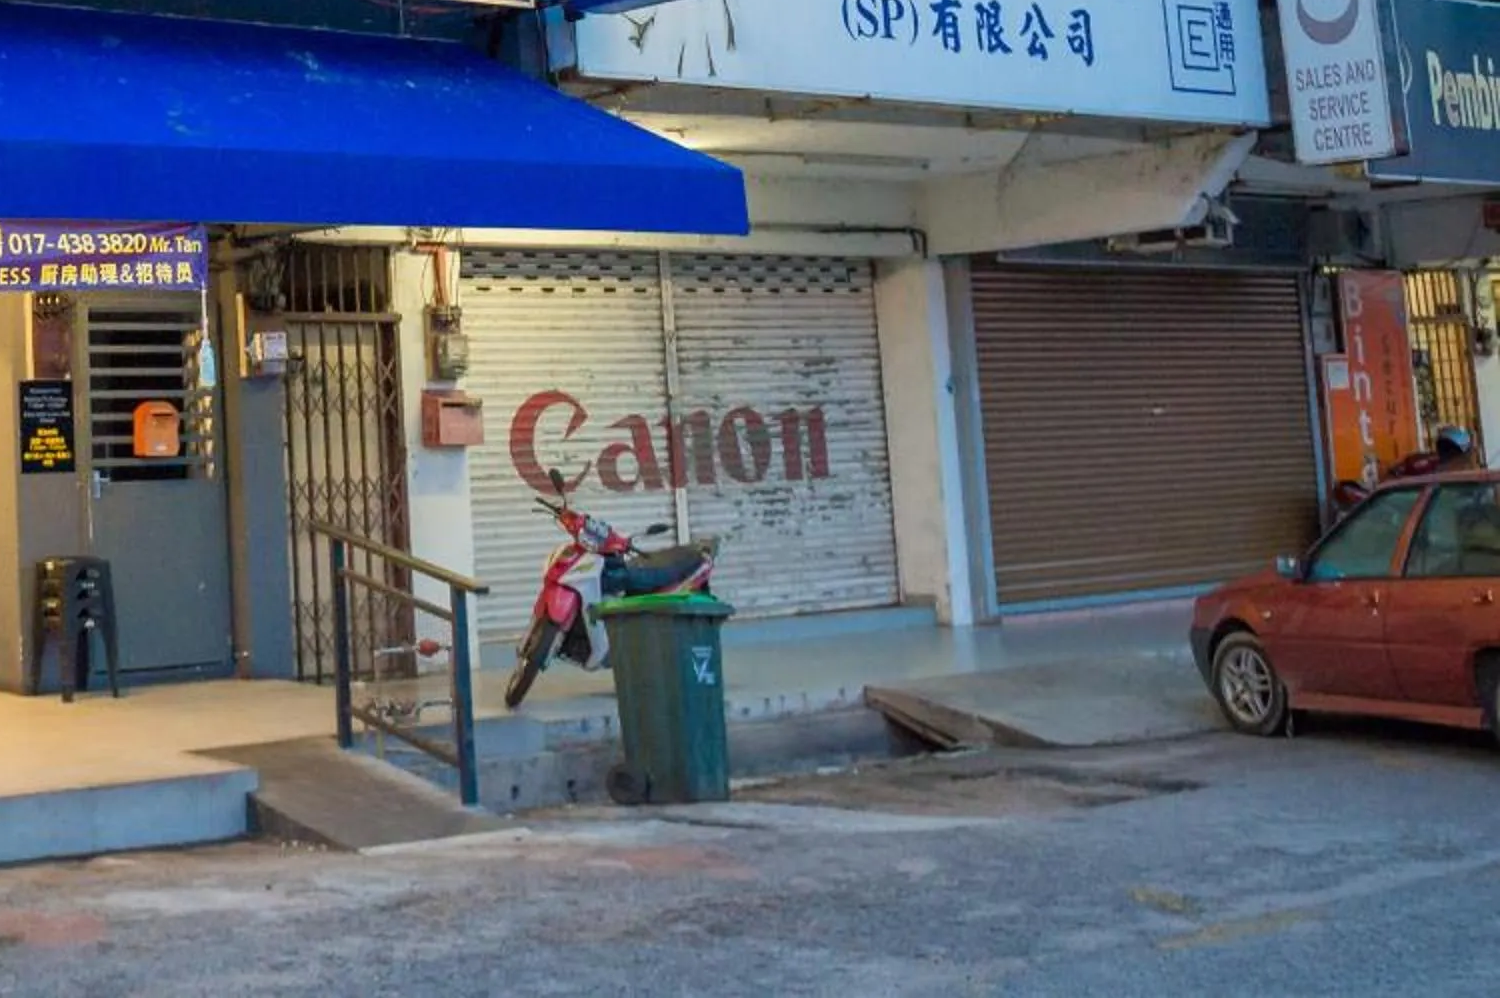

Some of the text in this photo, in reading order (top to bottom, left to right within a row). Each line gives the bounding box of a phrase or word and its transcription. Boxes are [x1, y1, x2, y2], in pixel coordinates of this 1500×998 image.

[1295, 59, 1376, 91] SALES AND
[1426, 50, 1500, 130] Pembi
[1309, 92, 1372, 121] SERVICE
[1313, 123, 1373, 151] CENTRE
[7, 233, 95, 255] 017-438
[99, 233, 147, 254] 3820
[149, 239, 173, 253] Mr.
[175, 236, 202, 253] Tan
[508, 390, 831, 496] Canon
